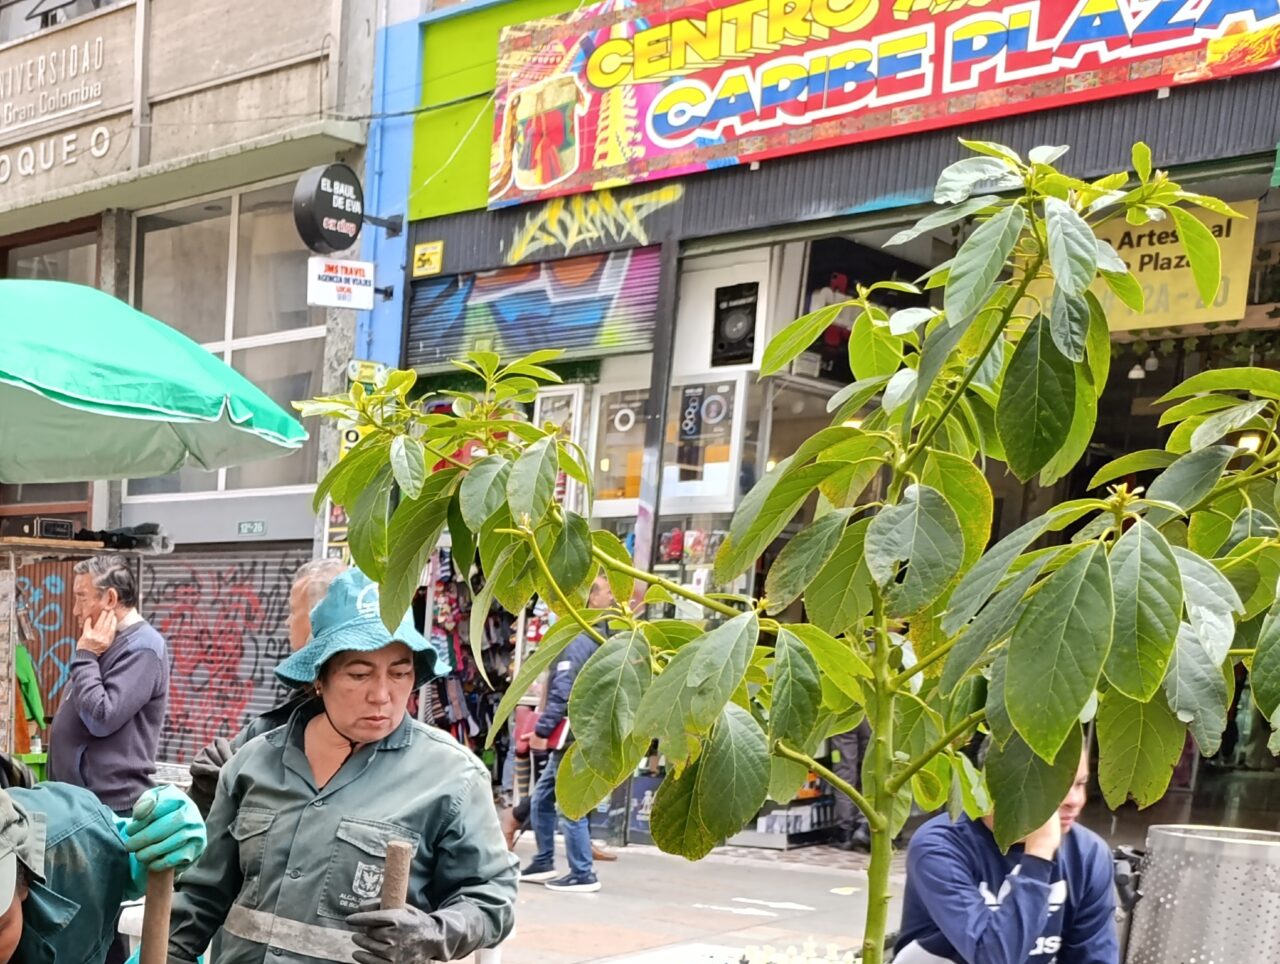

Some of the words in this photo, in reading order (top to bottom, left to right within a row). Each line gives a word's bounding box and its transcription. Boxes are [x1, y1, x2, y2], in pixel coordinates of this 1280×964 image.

[647, 25, 933, 146] CARIBE
[3, 101, 35, 125] Gran
[39, 81, 103, 113] Colombia
[320, 177, 333, 193] EL
[332, 195, 345, 209] DE
[345, 198, 362, 215] EVA
[1118, 217, 1232, 250] Artesal
